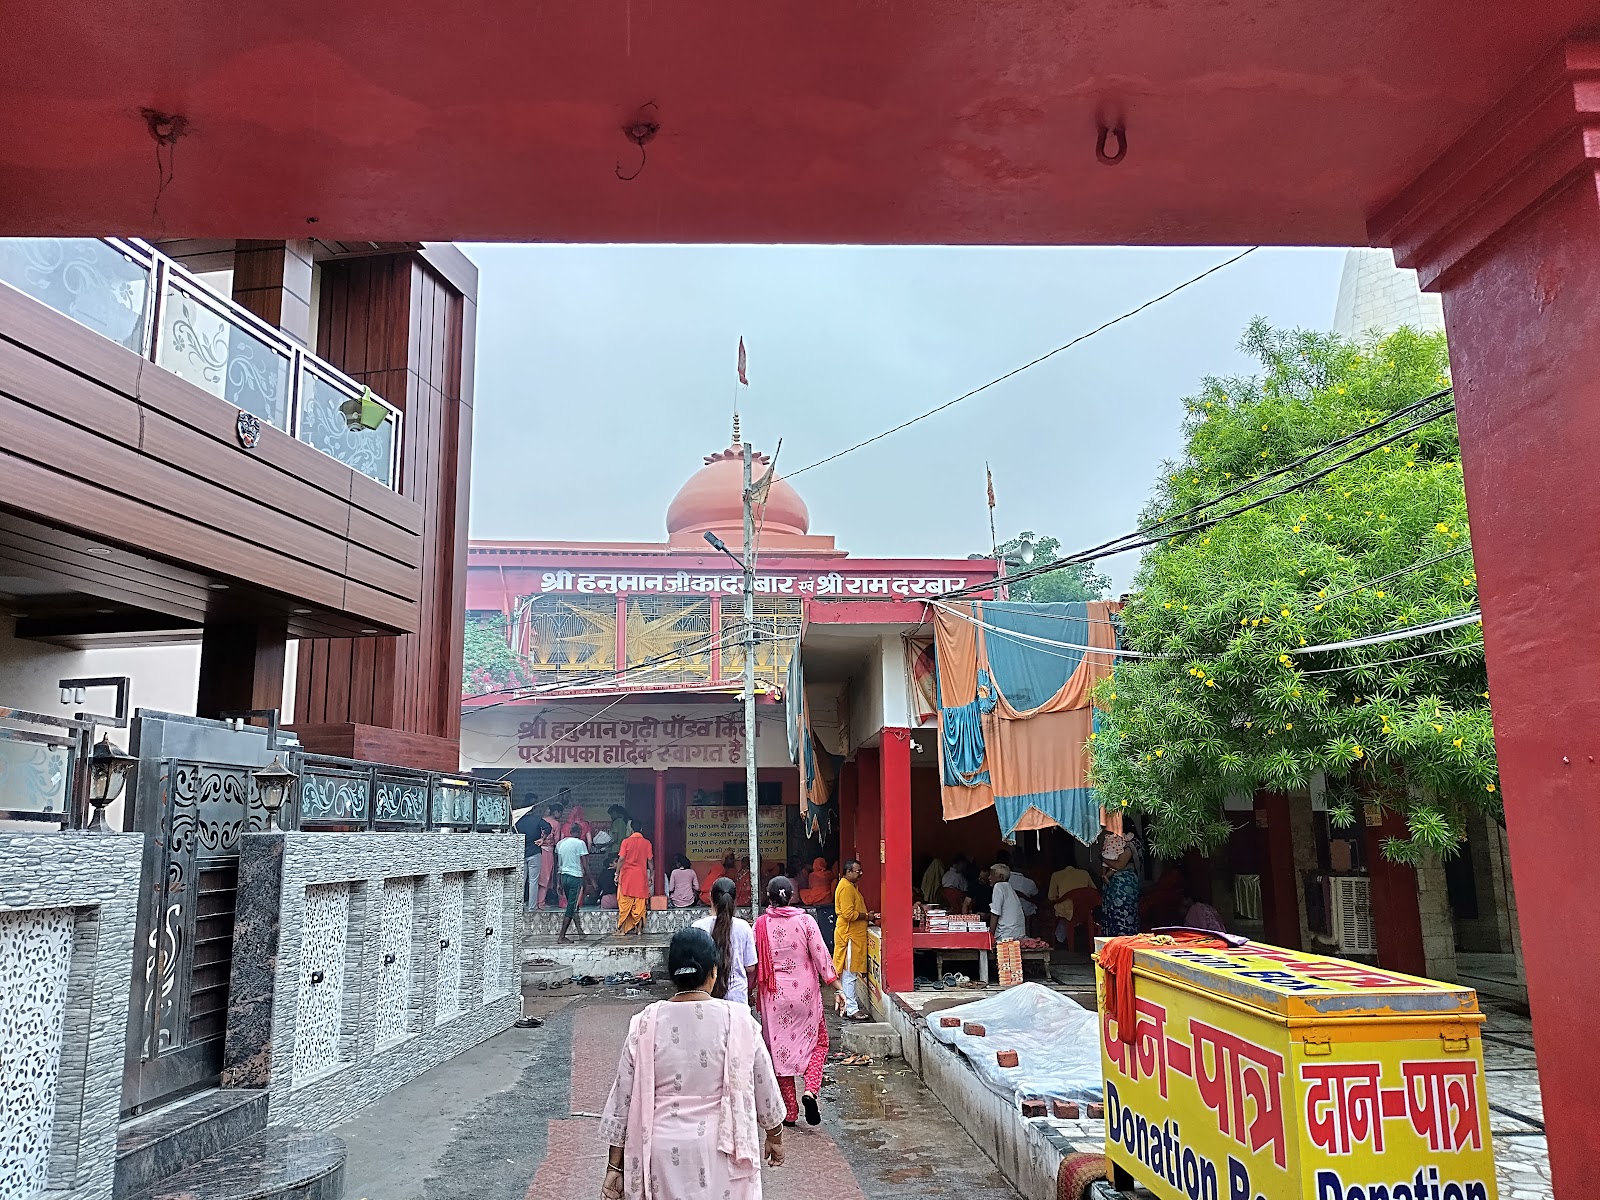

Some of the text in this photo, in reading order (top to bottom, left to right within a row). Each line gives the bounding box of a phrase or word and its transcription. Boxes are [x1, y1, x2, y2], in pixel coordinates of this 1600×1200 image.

[541, 571, 575, 592] श्री
[577, 574, 664, 594] हनुमान
[817, 571, 844, 595] श्री
[845, 577, 891, 594] राम
[893, 577, 967, 596] दरबार
[518, 718, 548, 739] श्री
[551, 721, 620, 742] हनुमान
[657, 744, 726, 762] स्वागत
[689, 807, 705, 819] श्री
[759, 807, 784, 819] सोई
[1233, 971, 1333, 991] Box
[1302, 1061, 1482, 1154] दान-पात्र
[1106, 1080, 1217, 1200] Donation
